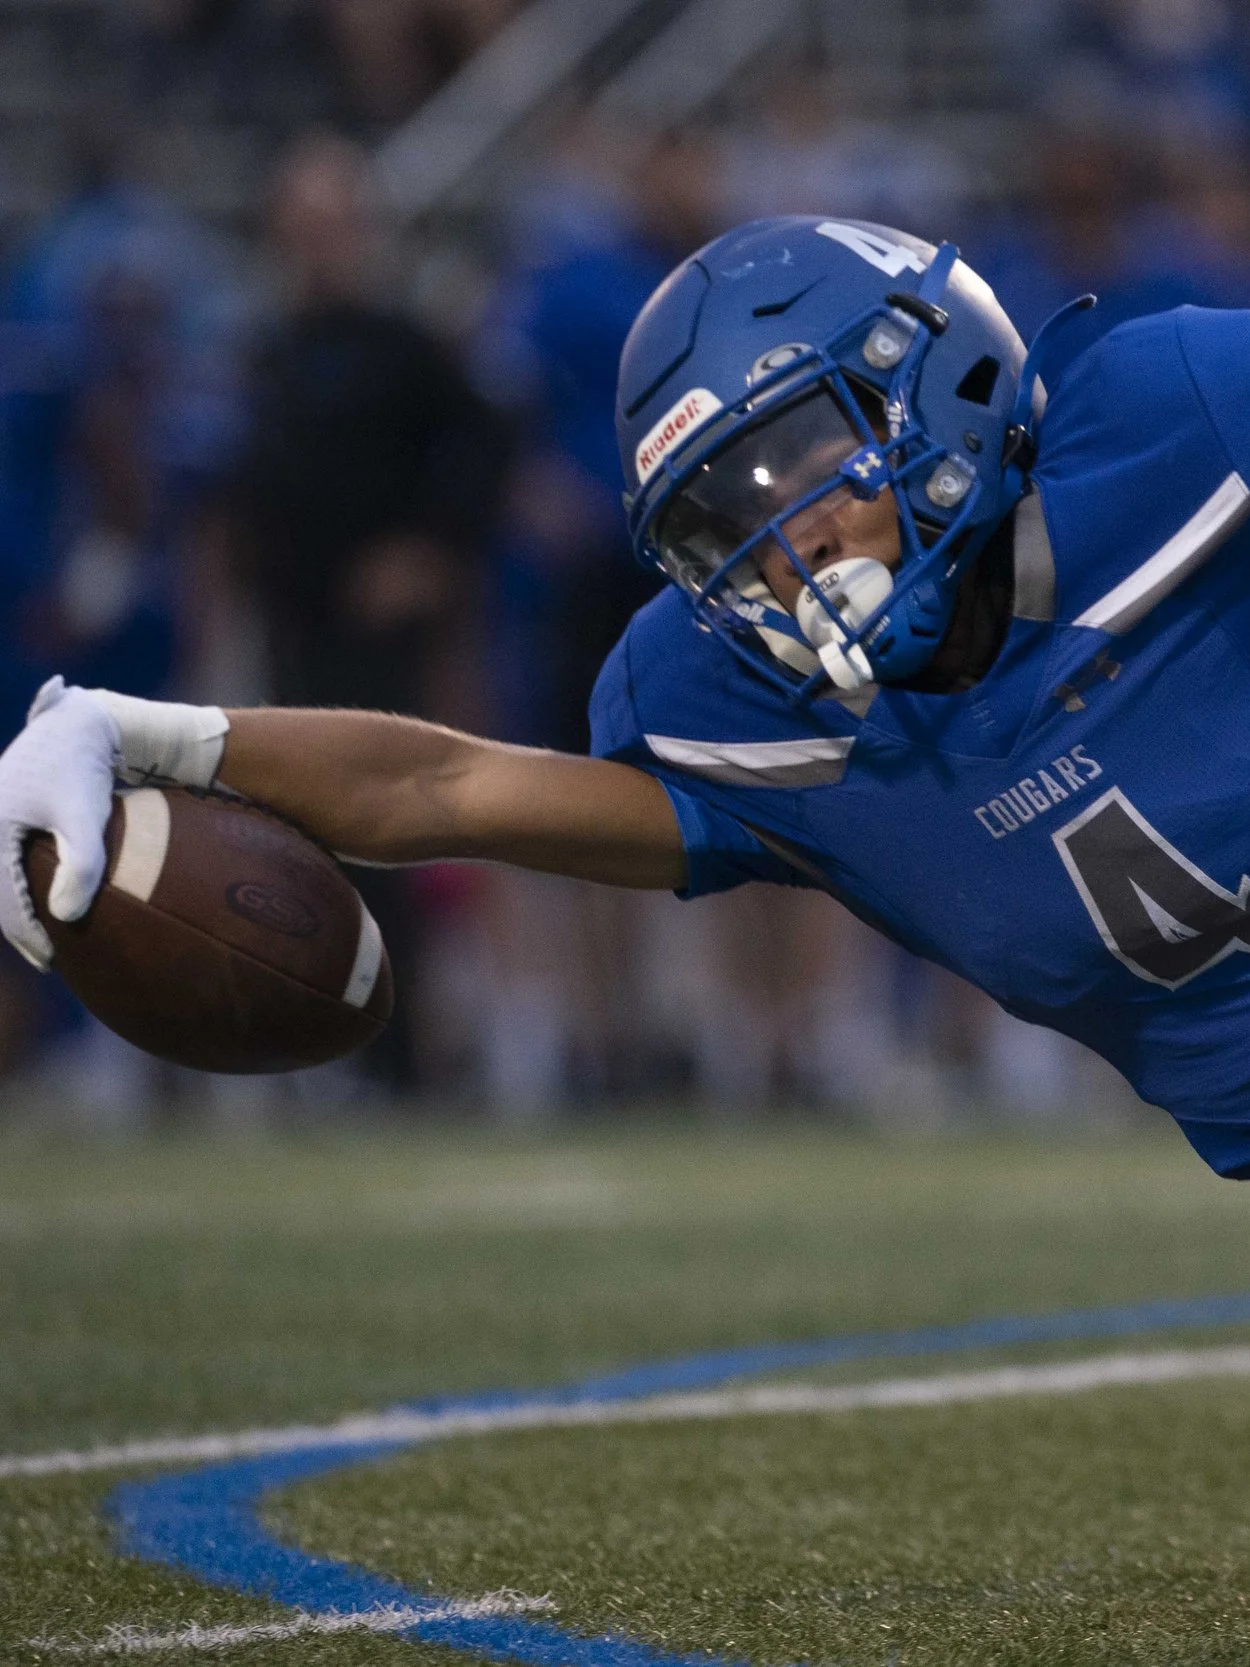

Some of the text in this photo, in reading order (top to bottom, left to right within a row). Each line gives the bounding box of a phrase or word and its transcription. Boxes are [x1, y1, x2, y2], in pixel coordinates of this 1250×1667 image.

[816, 222, 926, 278] 4
[638, 394, 704, 470] Riddell
[974, 744, 1103, 839] COUGARS
